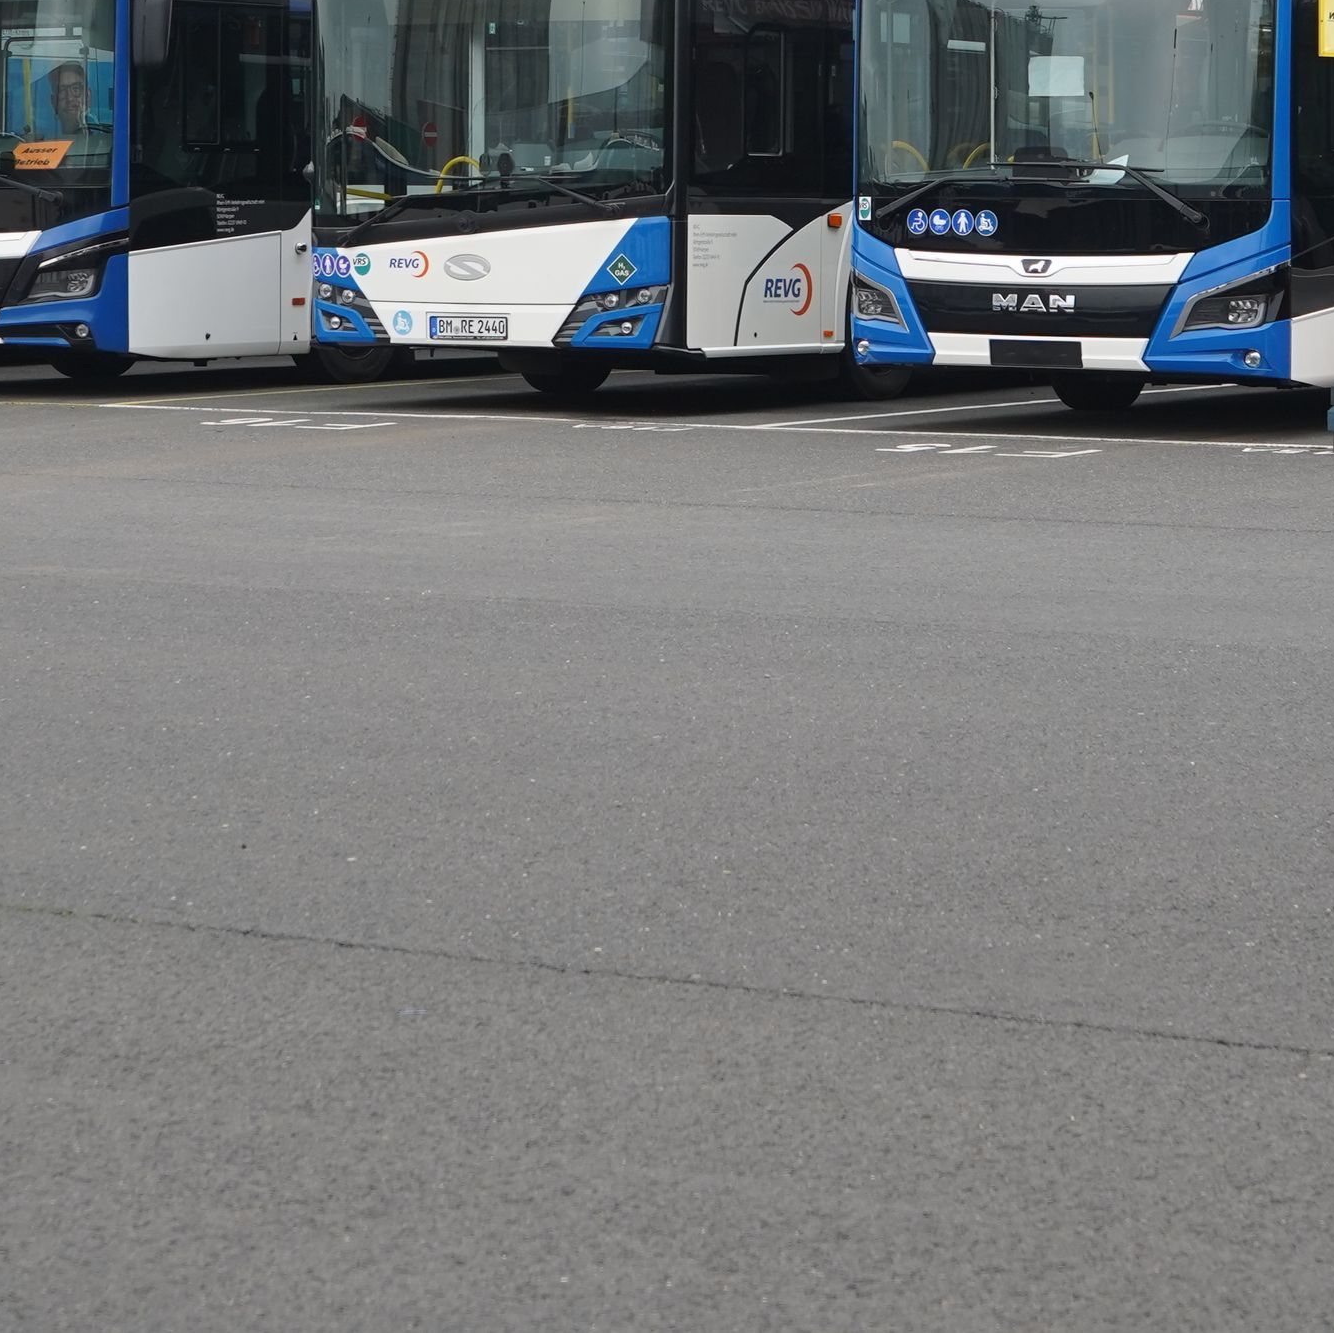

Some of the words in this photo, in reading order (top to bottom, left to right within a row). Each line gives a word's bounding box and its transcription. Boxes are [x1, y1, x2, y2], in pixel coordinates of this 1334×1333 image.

[352, 258, 367, 266] VRS
[389, 258, 420, 268] REVG
[614, 269, 630, 277] GAS
[764, 278, 802, 298] REVG
[992, 293, 1076, 313] MAN
[438, 319, 453, 333] BM
[460, 319, 475, 334] RE
[477, 320, 505, 335] 2440
